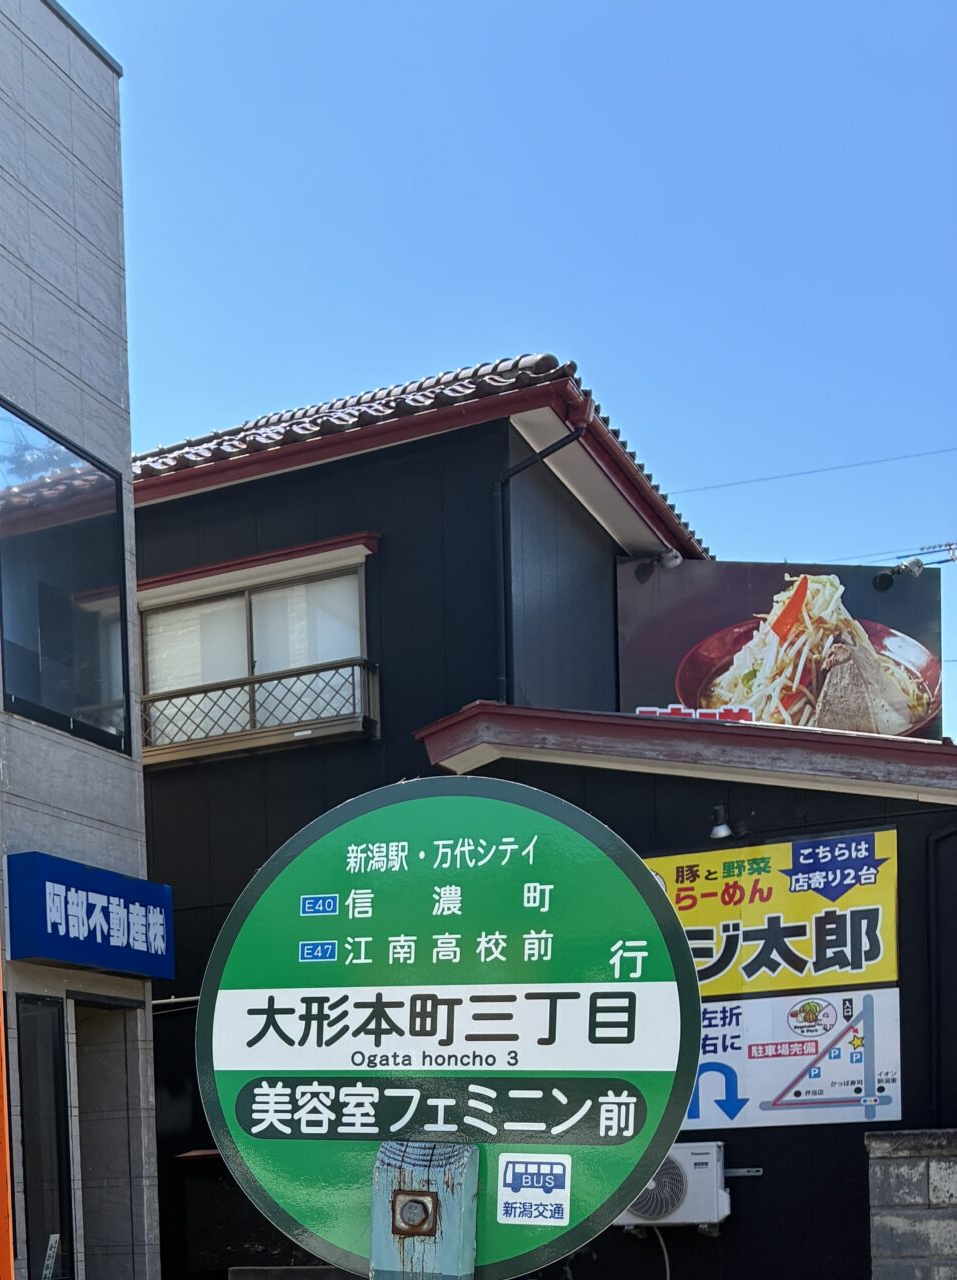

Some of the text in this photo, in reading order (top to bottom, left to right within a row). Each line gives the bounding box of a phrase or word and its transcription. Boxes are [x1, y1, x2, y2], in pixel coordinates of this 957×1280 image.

[799, 840, 869, 865] こちらは
[675, 856, 772, 885] 豚と野菜
[790, 865, 879, 893] 店寄り2台
[305, 899, 334, 912] E40
[675, 878, 773, 911] らーめん
[304, 945, 332, 958] E47
[345, 929, 649, 979] 江南高校前 行
[246, 991, 637, 1049] 大形本町三丁目
[351, 1050, 519, 1070] Ogata honcho 3
[250, 1080, 638, 1138] 美容室フェミニン前
[522, 1174, 555, 1187] BUS
[502, 1201, 564, 1220] 新潟交通
